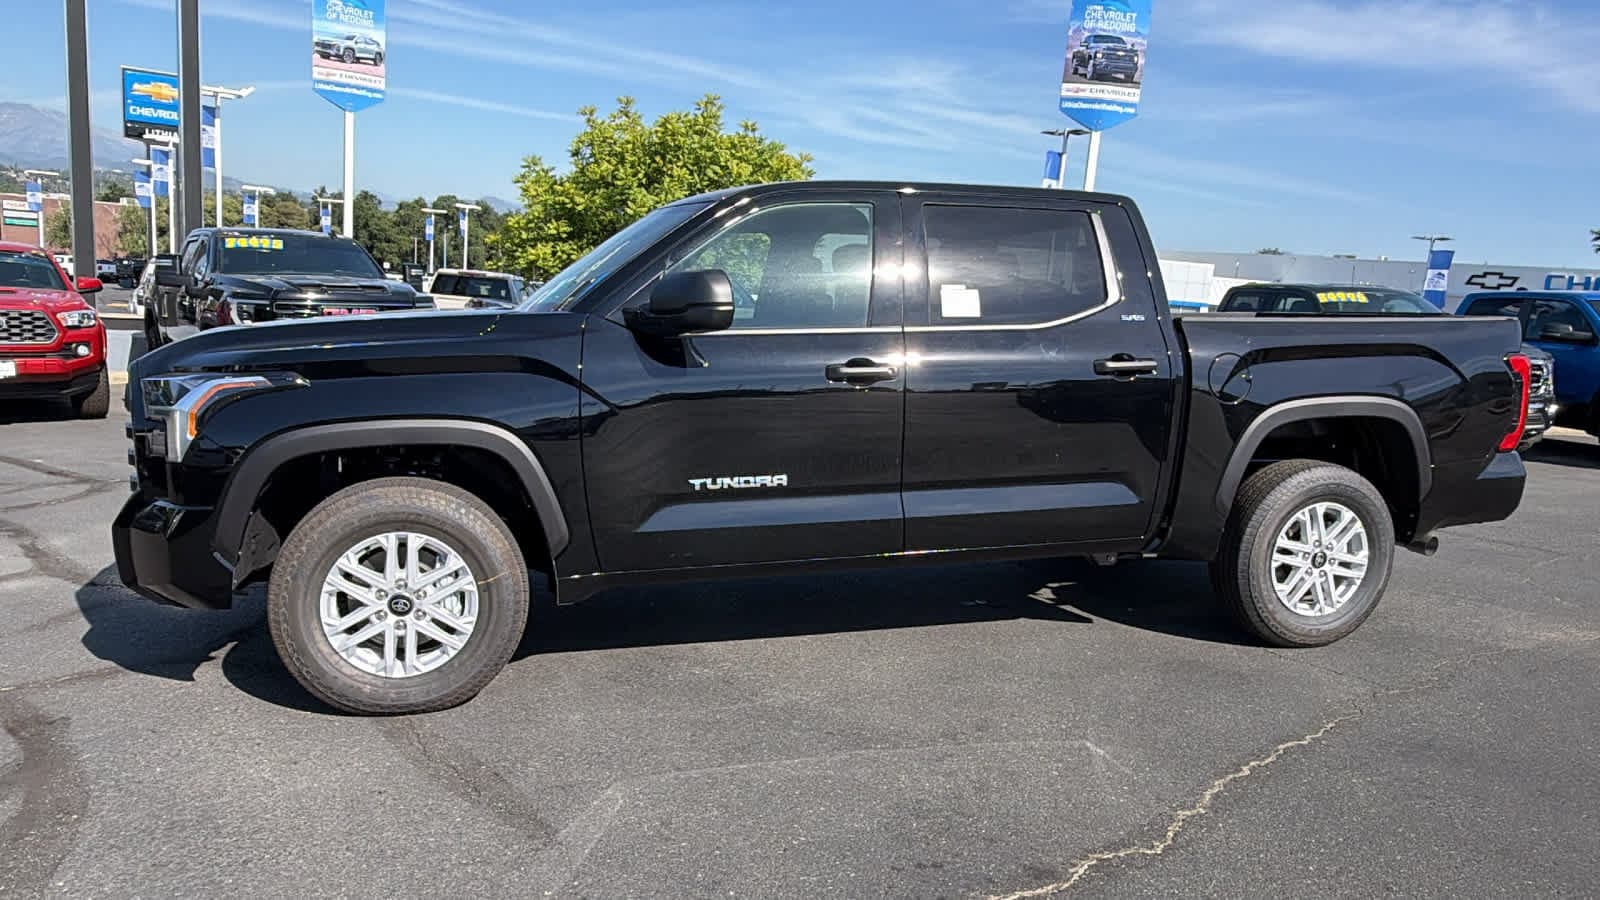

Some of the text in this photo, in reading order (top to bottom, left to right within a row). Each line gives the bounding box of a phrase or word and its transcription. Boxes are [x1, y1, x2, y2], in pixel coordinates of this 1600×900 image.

[326, 2, 374, 20] CHEVROLET
[1084, 9, 1137, 22] CHEVROLET
[1096, 20, 1136, 32] REDDING
[1089, 87, 1137, 98] CHEVROLET
[129, 105, 179, 121] CHEVROL
[687, 474, 788, 491] TUNDRA
